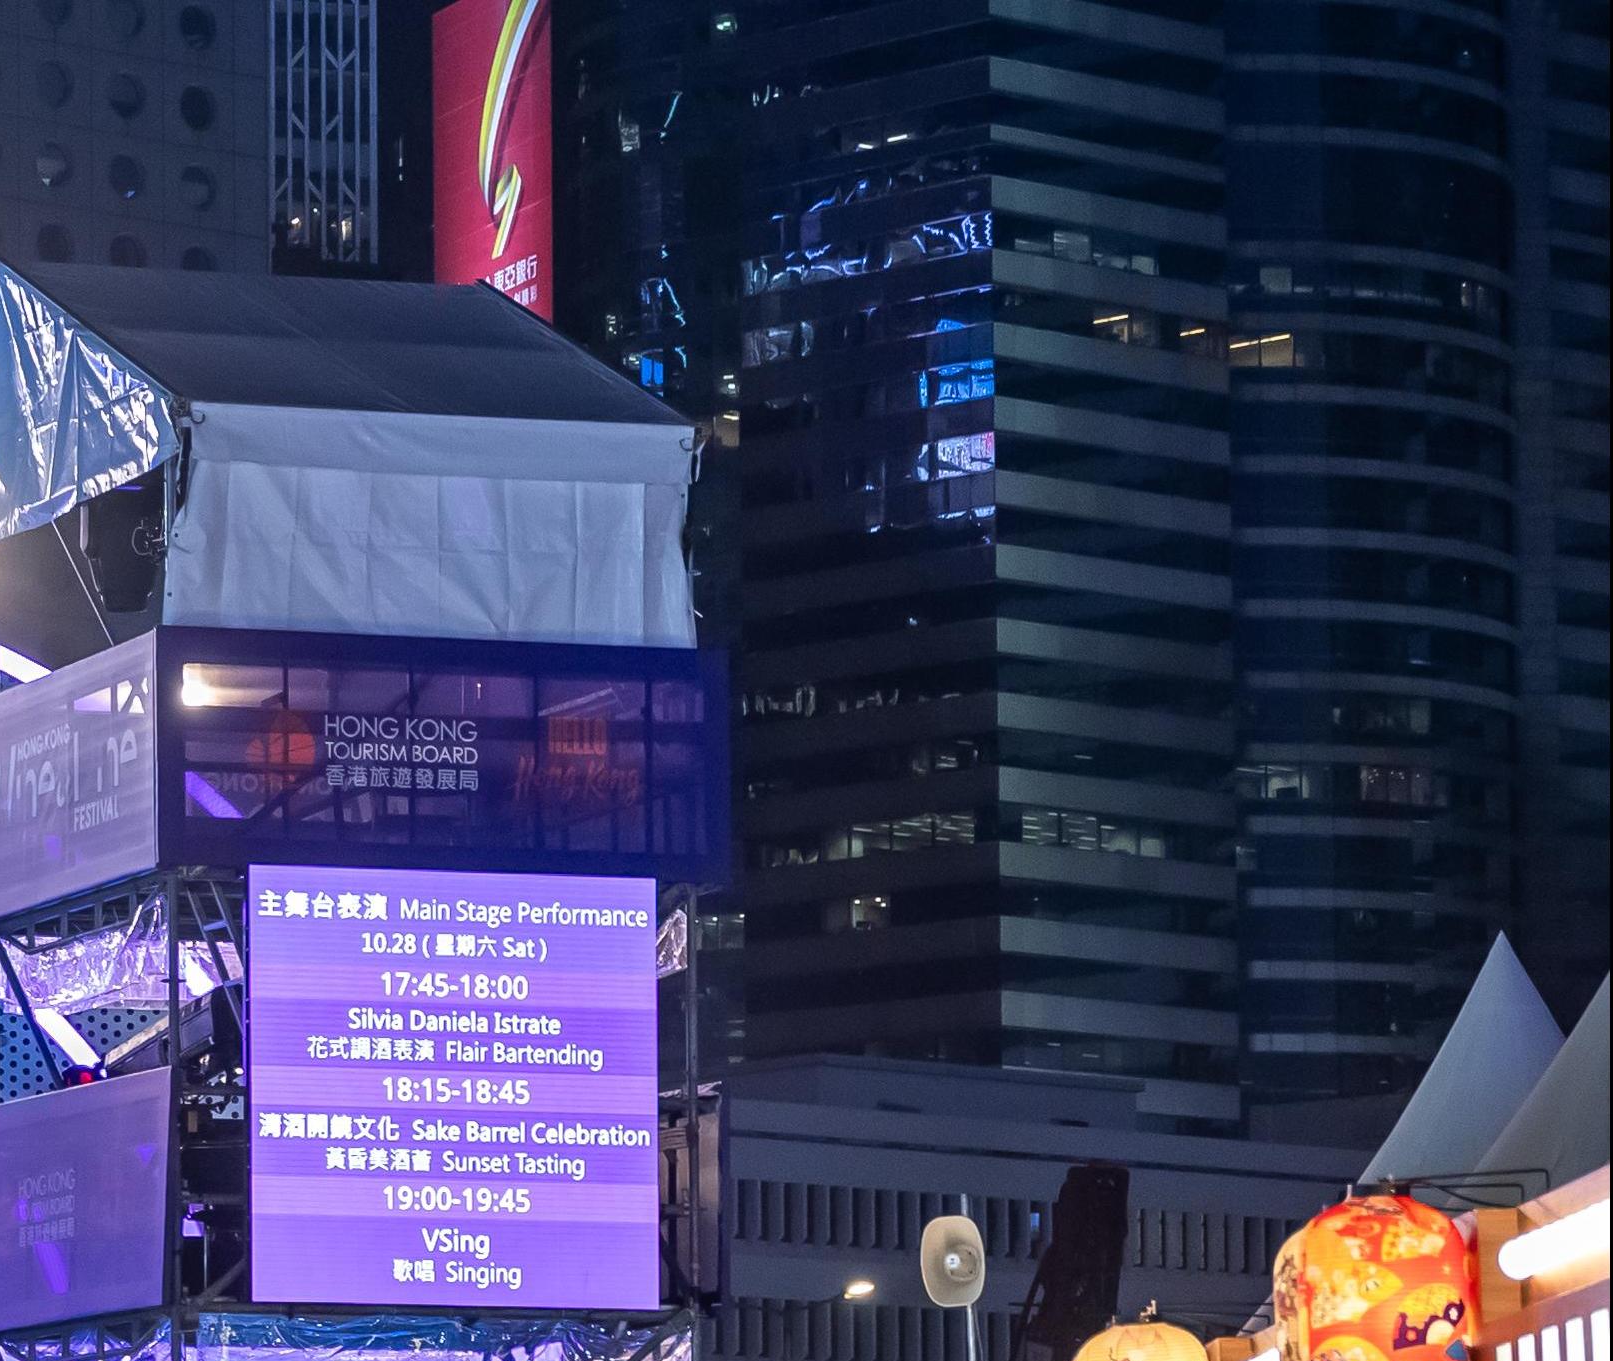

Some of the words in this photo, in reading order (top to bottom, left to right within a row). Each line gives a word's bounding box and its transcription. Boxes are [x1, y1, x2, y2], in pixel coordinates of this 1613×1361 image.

[325, 714, 399, 739] HONG
[405, 718, 478, 742] KONG
[325, 741, 407, 762] TOURISM
[412, 744, 478, 764] BOARD
[325, 764, 479, 792] 香港旅遊發展局
[258, 890, 387, 921] 主舞台表演
[401, 899, 450, 921] Main
[456, 900, 511, 928] Stage
[518, 900, 648, 928] Performance
[362, 933, 416, 955] 10.28
[381, 972, 528, 999] 17:45-18:00
[348, 1007, 402, 1032] Silvia
[410, 1009, 488, 1034] Daniela
[494, 1012, 561, 1035] Istrate
[307, 1036, 435, 1061] 花式調酒表演
[446, 1040, 487, 1063] Flair
[493, 1042, 603, 1071] Bartending
[383, 1077, 530, 1104] 18:15-18:45
[412, 1120, 460, 1142] Sake
[467, 1121, 525, 1143] Barrel
[531, 1121, 650, 1147] Celebration
[443, 1153, 510, 1173] Sunset
[515, 1154, 585, 1180] Tasting
[384, 1186, 531, 1214] 19:00-19:45
[422, 1228, 491, 1259] VSing
[393, 1259, 435, 1283] 歌唱
[445, 1262, 522, 1290] Singing
